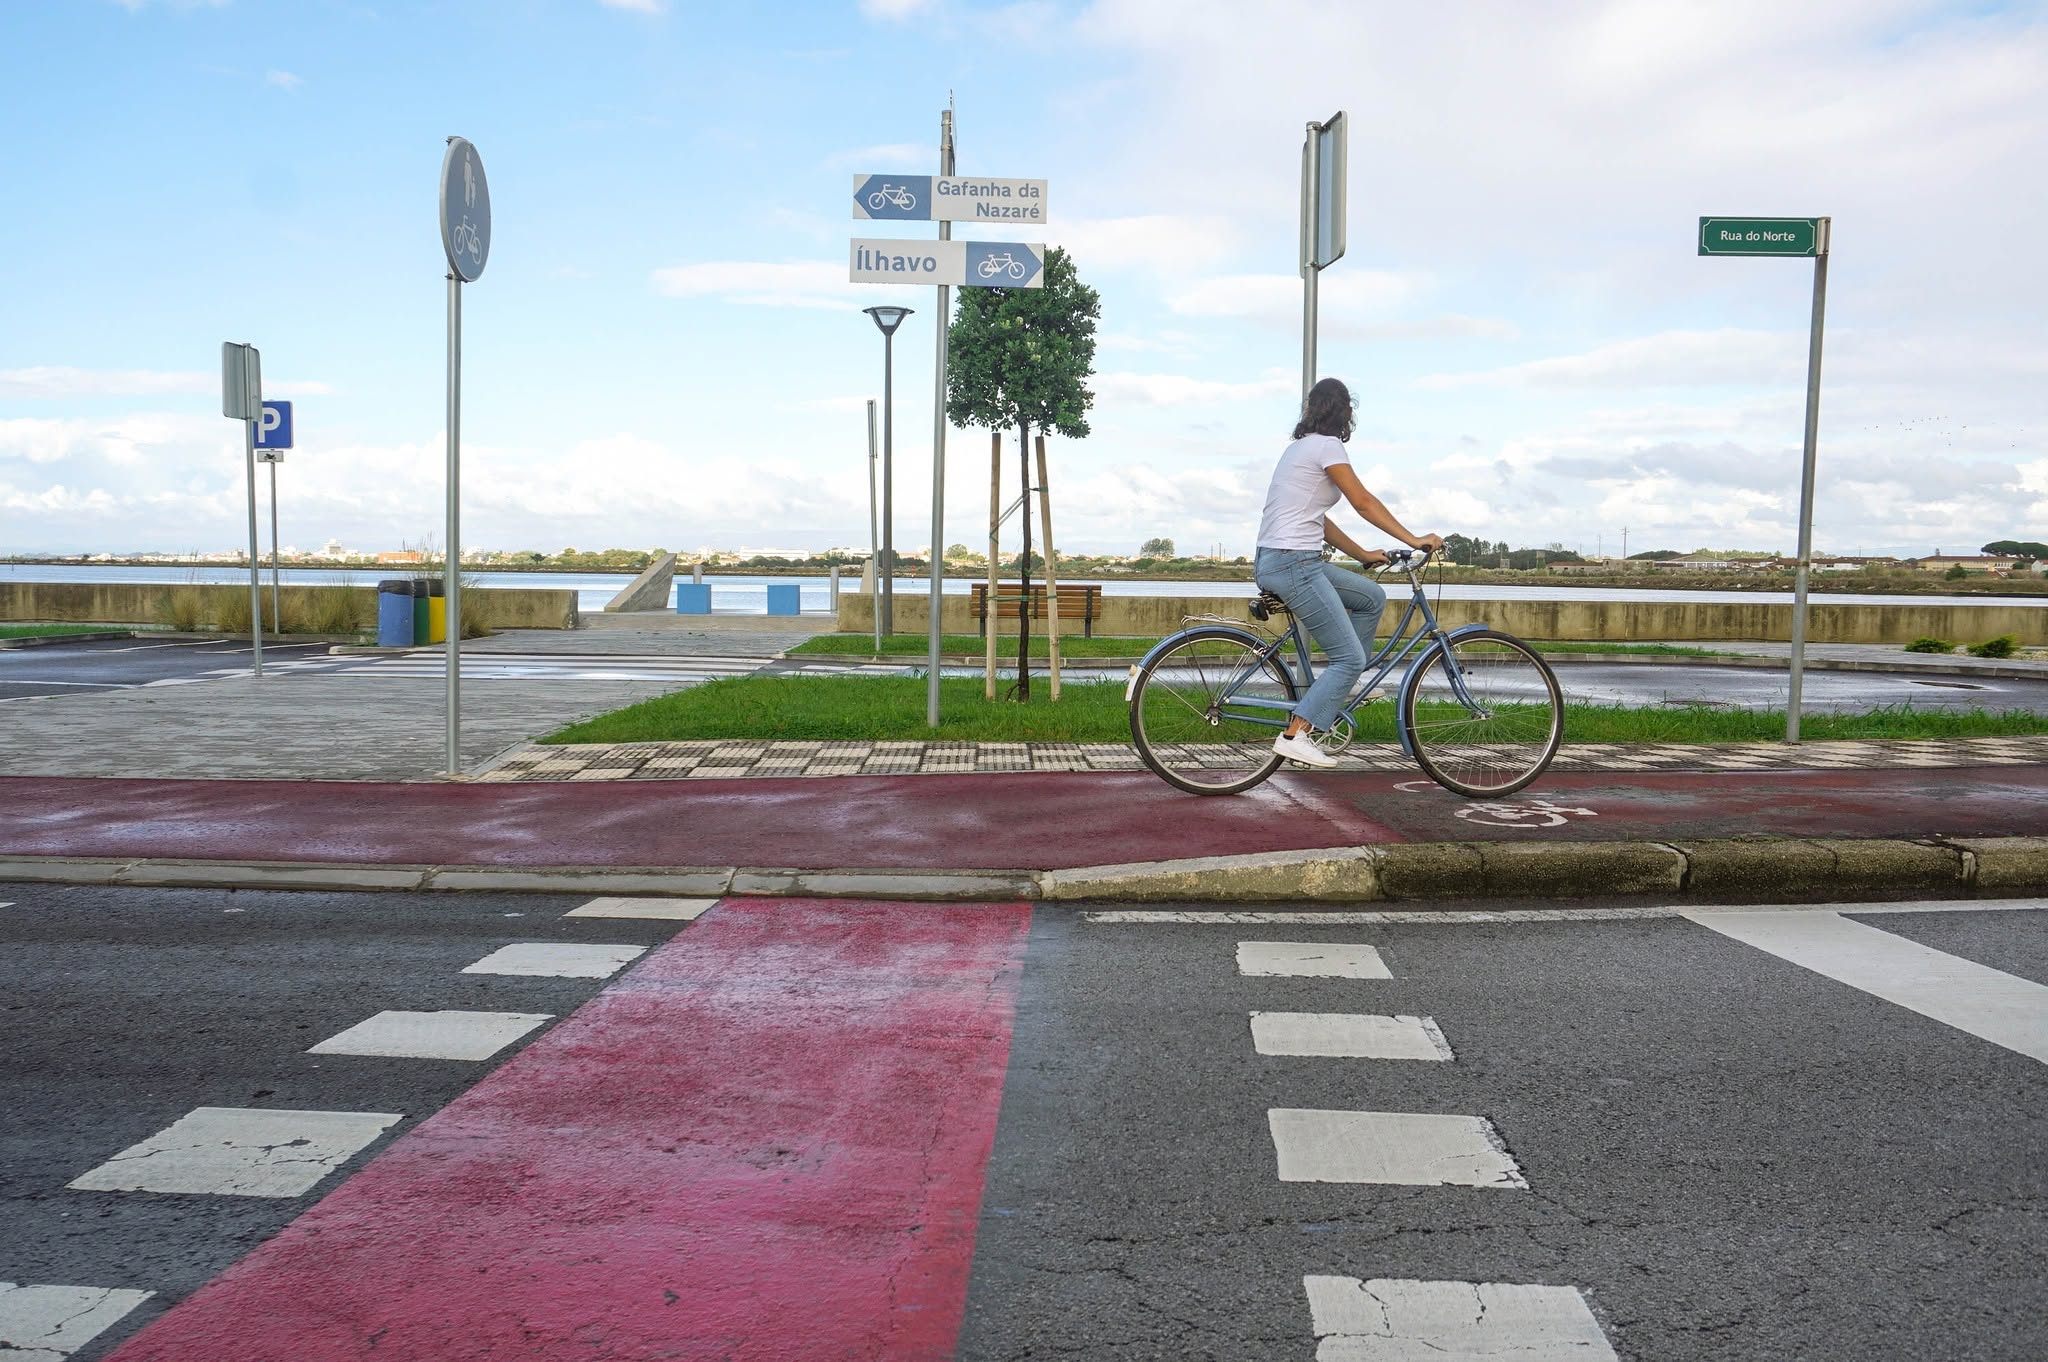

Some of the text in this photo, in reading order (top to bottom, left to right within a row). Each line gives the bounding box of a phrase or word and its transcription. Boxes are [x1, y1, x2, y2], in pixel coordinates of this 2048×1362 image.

[937, 180, 1040, 198] Gafanha da
[976, 202, 1040, 219] Nazaré
[1720, 230, 1796, 241] Rua do Norte
[857, 245, 937, 272] Ílhavo
[258, 407, 281, 443] P
